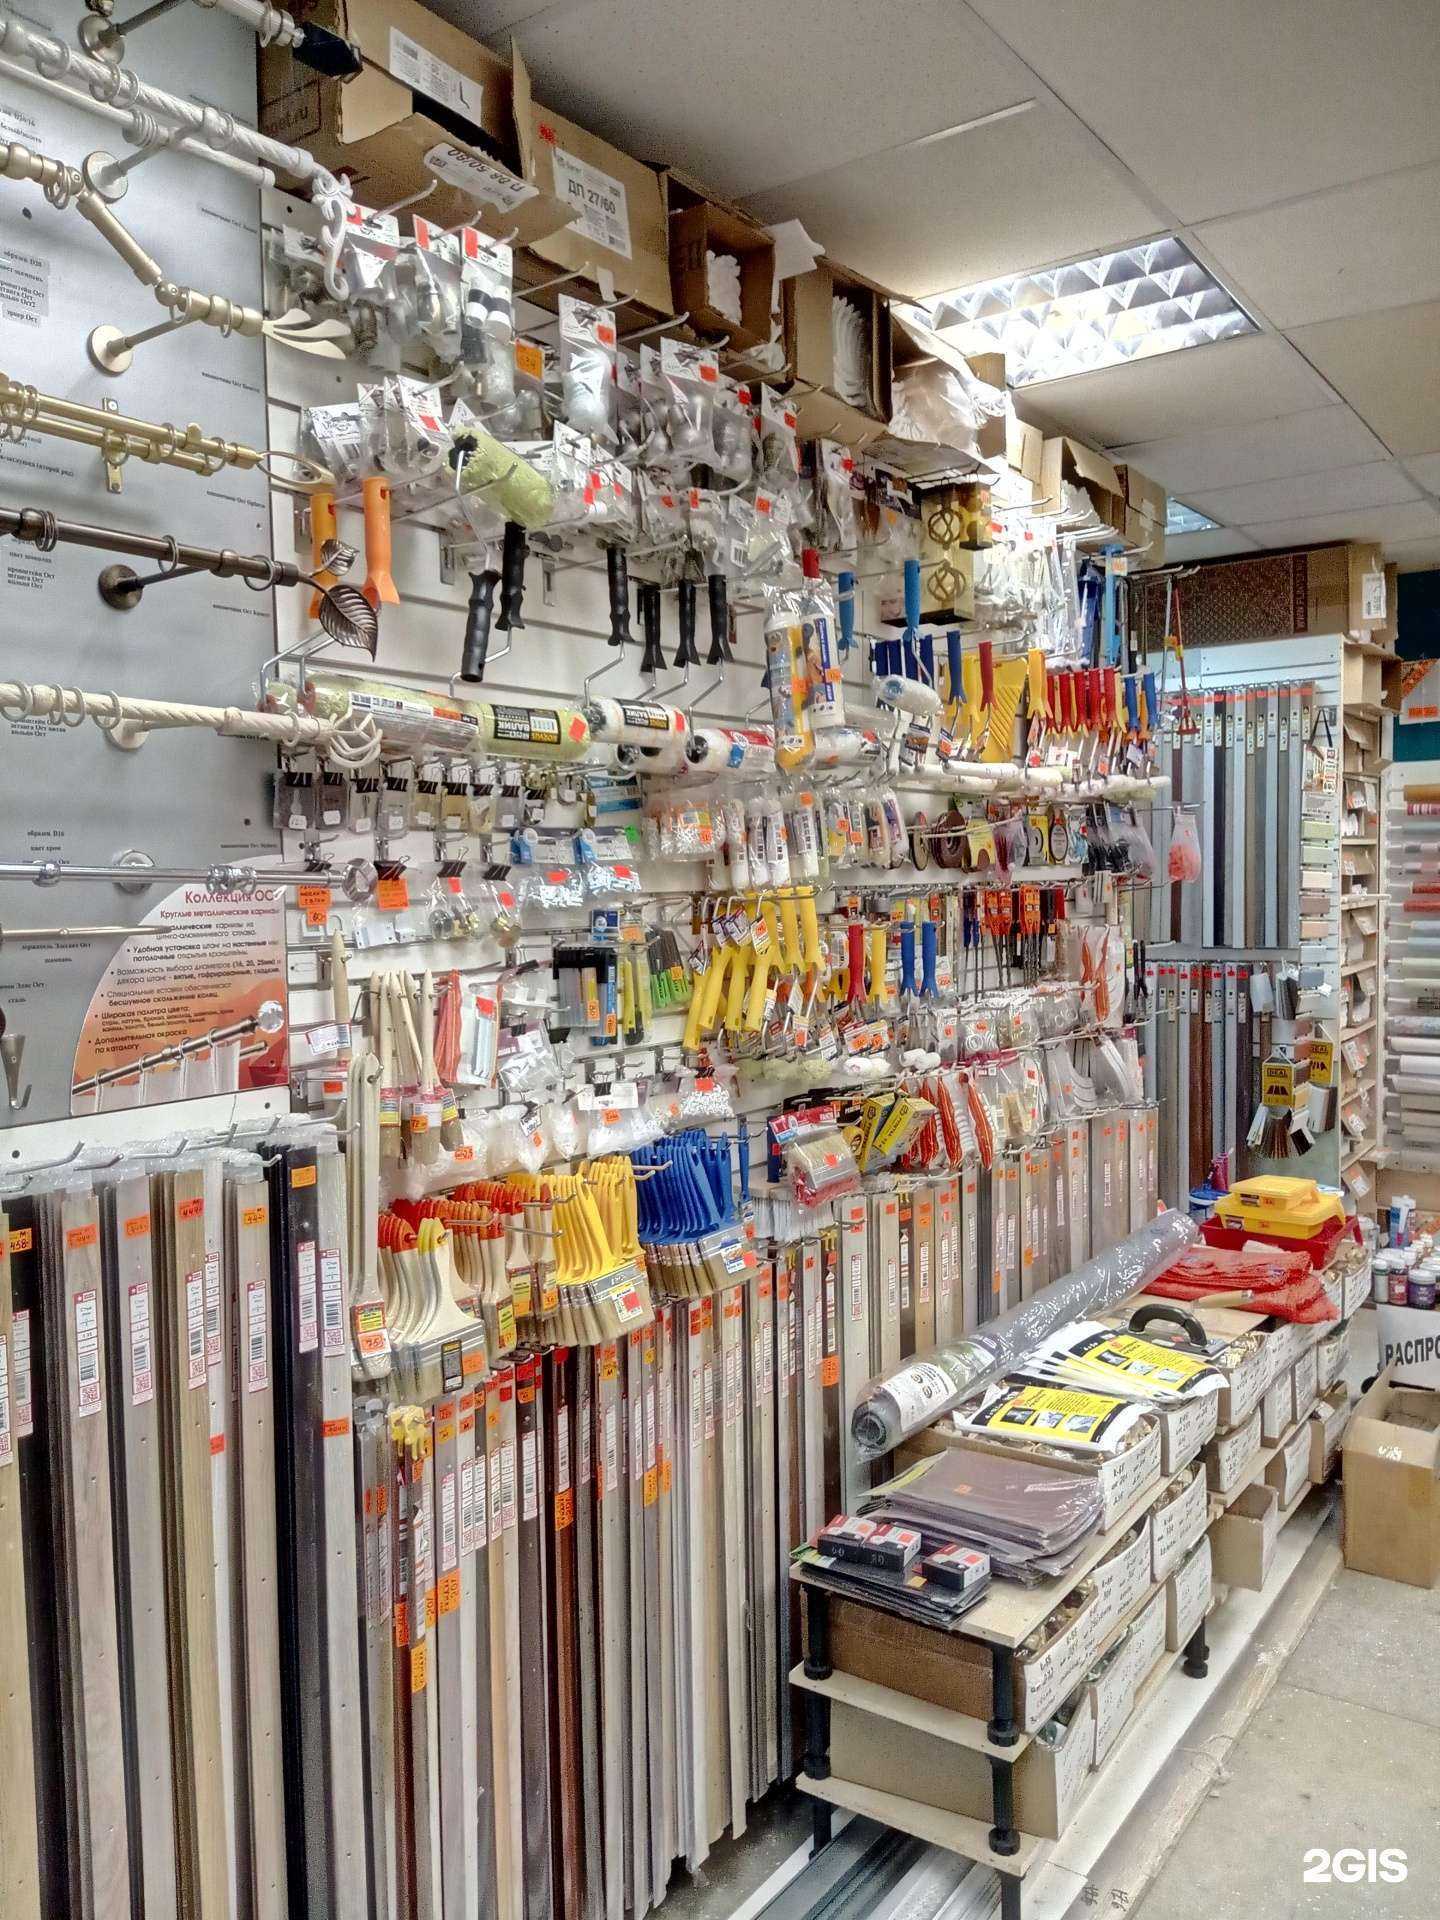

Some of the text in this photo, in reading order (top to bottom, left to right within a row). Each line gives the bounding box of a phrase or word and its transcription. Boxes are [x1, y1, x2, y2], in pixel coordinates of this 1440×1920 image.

[568, 178, 616, 215] ДП 27/60
[185, 888, 276, 904] Коллекция ОС
[160, 910, 192, 919] Круглые
[193, 908, 249, 917] металлические
[133, 945, 163, 954] Удобная
[165, 943, 201, 952] установка
[133, 953, 175, 962] потолочные
[116, 967, 165, 976] Возможность
[166, 965, 193, 973] выбора
[116, 976, 145, 986] декора
[106, 988, 155, 998] Специальные
[108, 997, 150, 1007] бесшумное
[153, 994, 196, 1003] скольжение
[101, 1010, 135, 1019] Широкая
[136, 1007, 166, 1017] палитра
[94, 1029, 188, 1046] Дополнительная окраска
[94, 1046, 105, 1054] по
